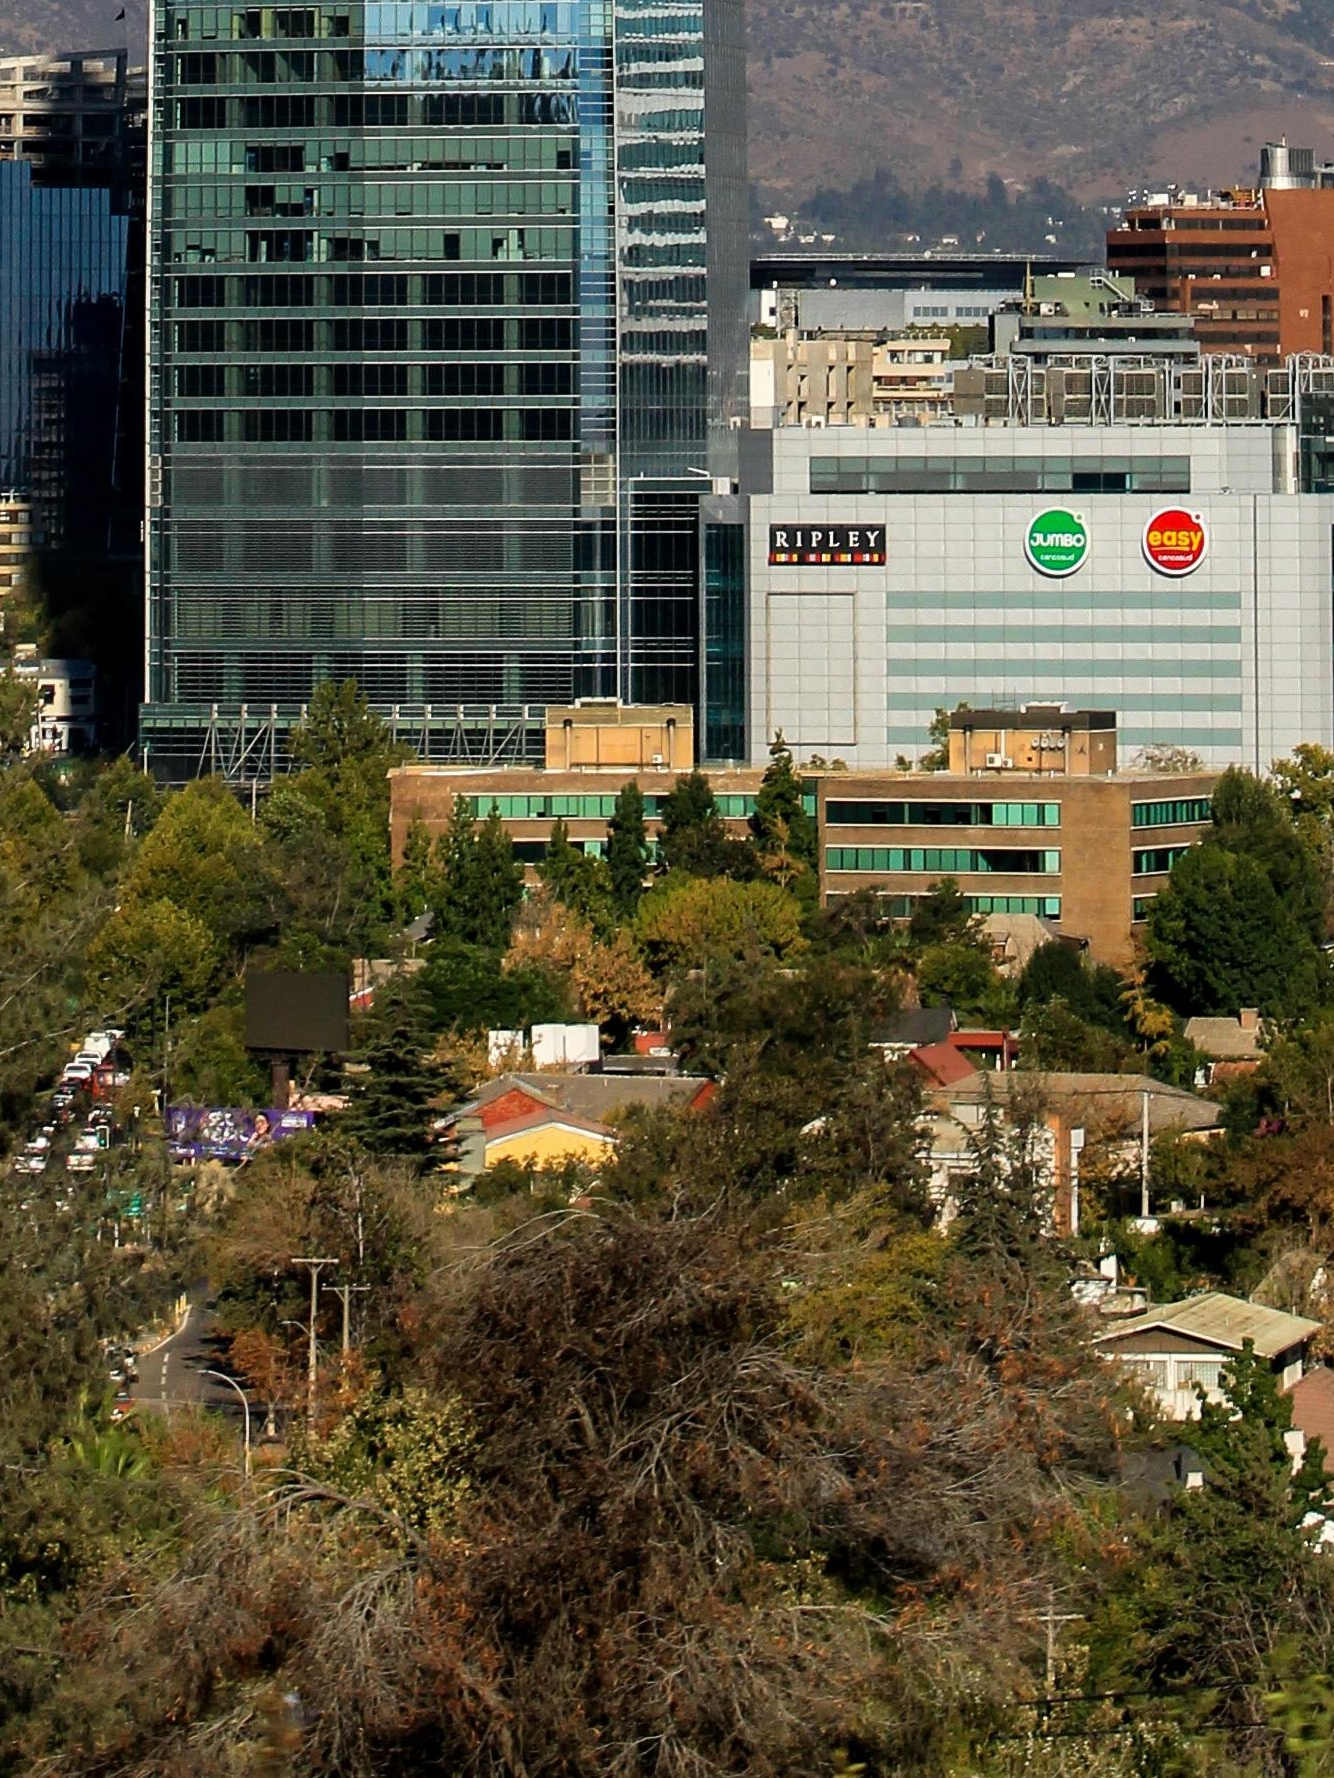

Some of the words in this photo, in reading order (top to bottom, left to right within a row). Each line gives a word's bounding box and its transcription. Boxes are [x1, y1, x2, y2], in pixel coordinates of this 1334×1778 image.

[775, 530, 880, 548] RIPLEY
[1030, 532, 1085, 548] JUMBO
[1147, 530, 1203, 551] easy
